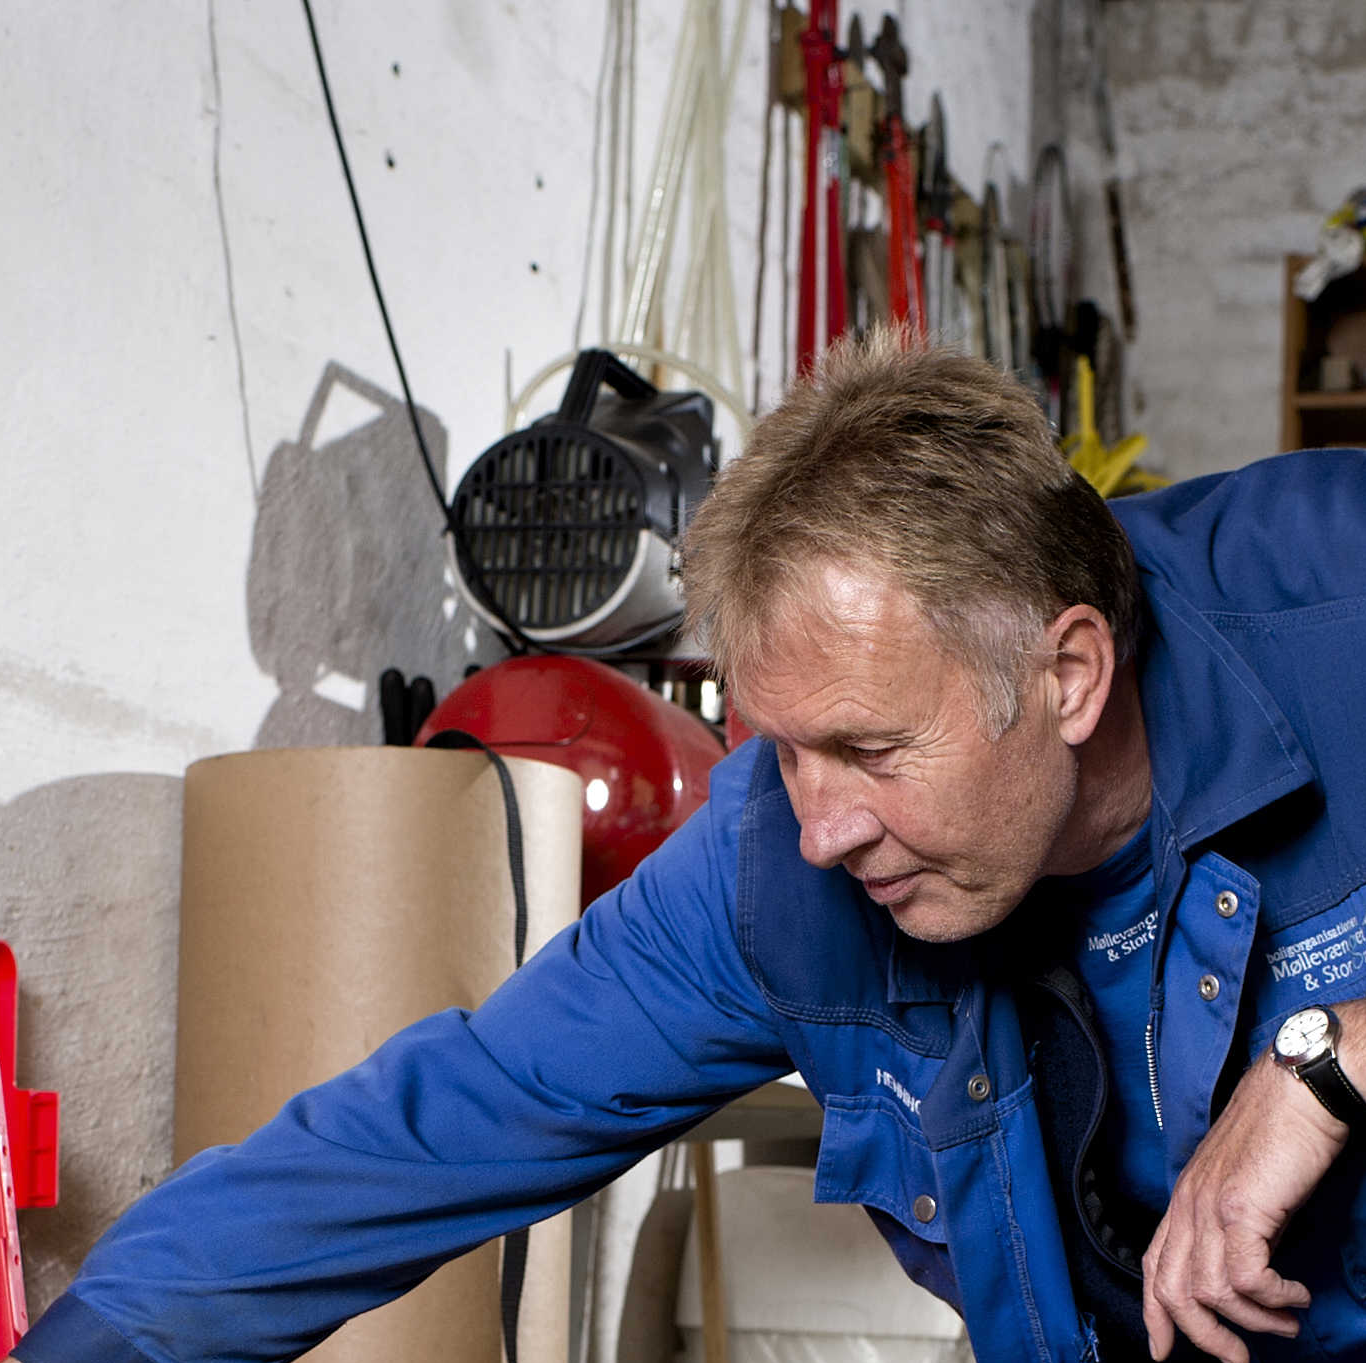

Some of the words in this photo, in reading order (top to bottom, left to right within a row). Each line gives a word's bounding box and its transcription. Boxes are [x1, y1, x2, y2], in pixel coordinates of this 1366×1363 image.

[1088, 910, 1158, 951] Møllevæng
[1107, 948, 1120, 962] &
[1303, 973, 1320, 991] &
